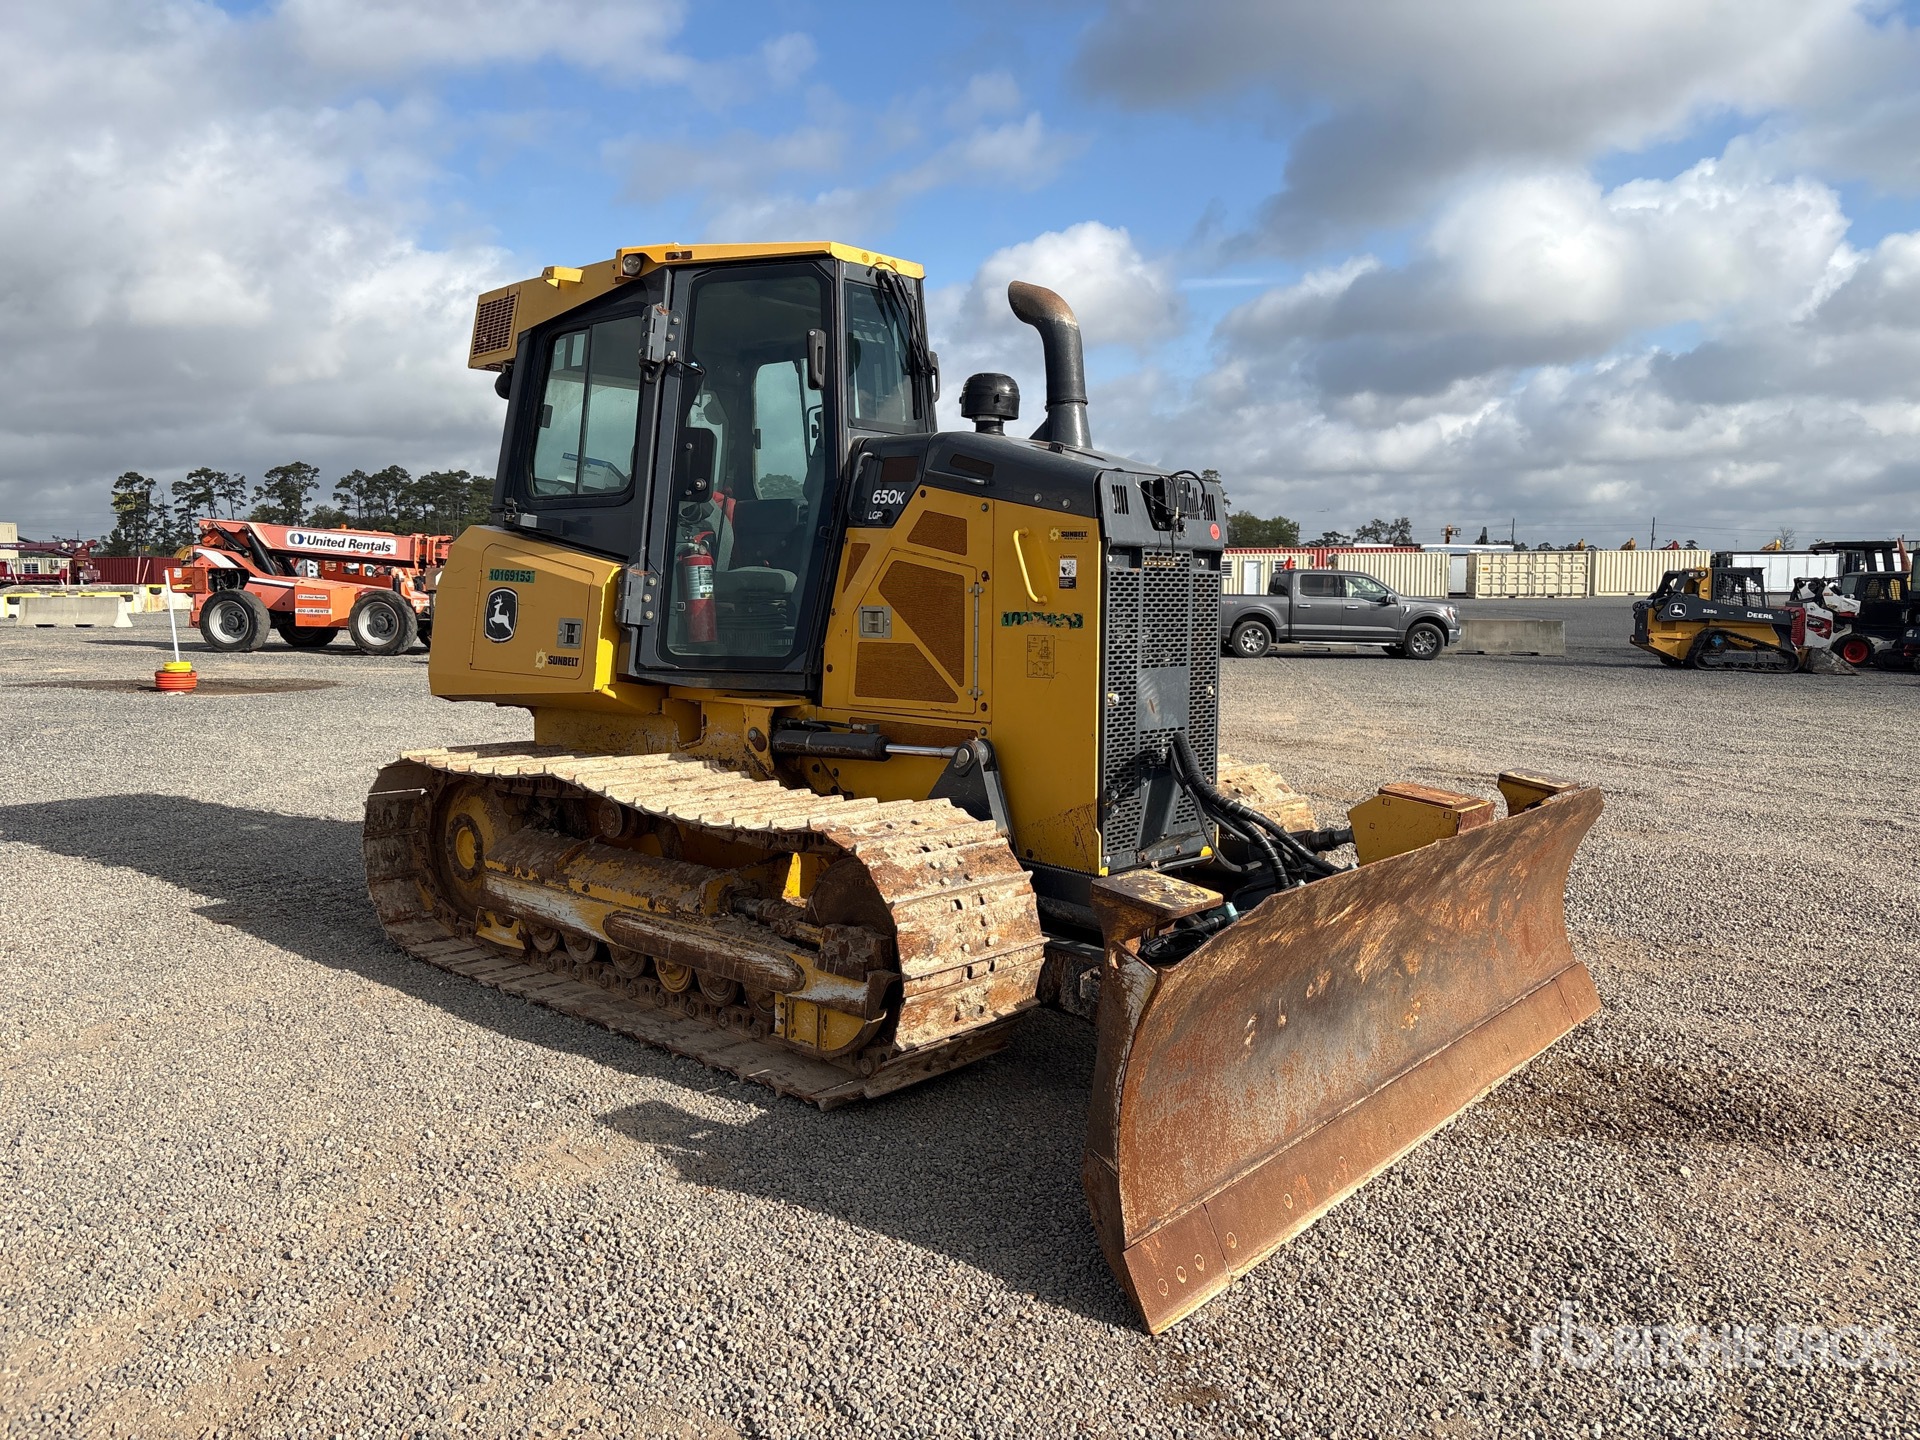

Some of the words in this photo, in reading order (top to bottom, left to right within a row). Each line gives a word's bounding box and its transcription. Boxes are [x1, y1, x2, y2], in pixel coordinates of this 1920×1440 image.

[872, 490, 905, 504] 650K
[868, 511, 883, 520] LGP
[306, 535, 346, 548] United
[348, 538, 391, 552] Rentals
[548, 656, 579, 667] SUNBELT
